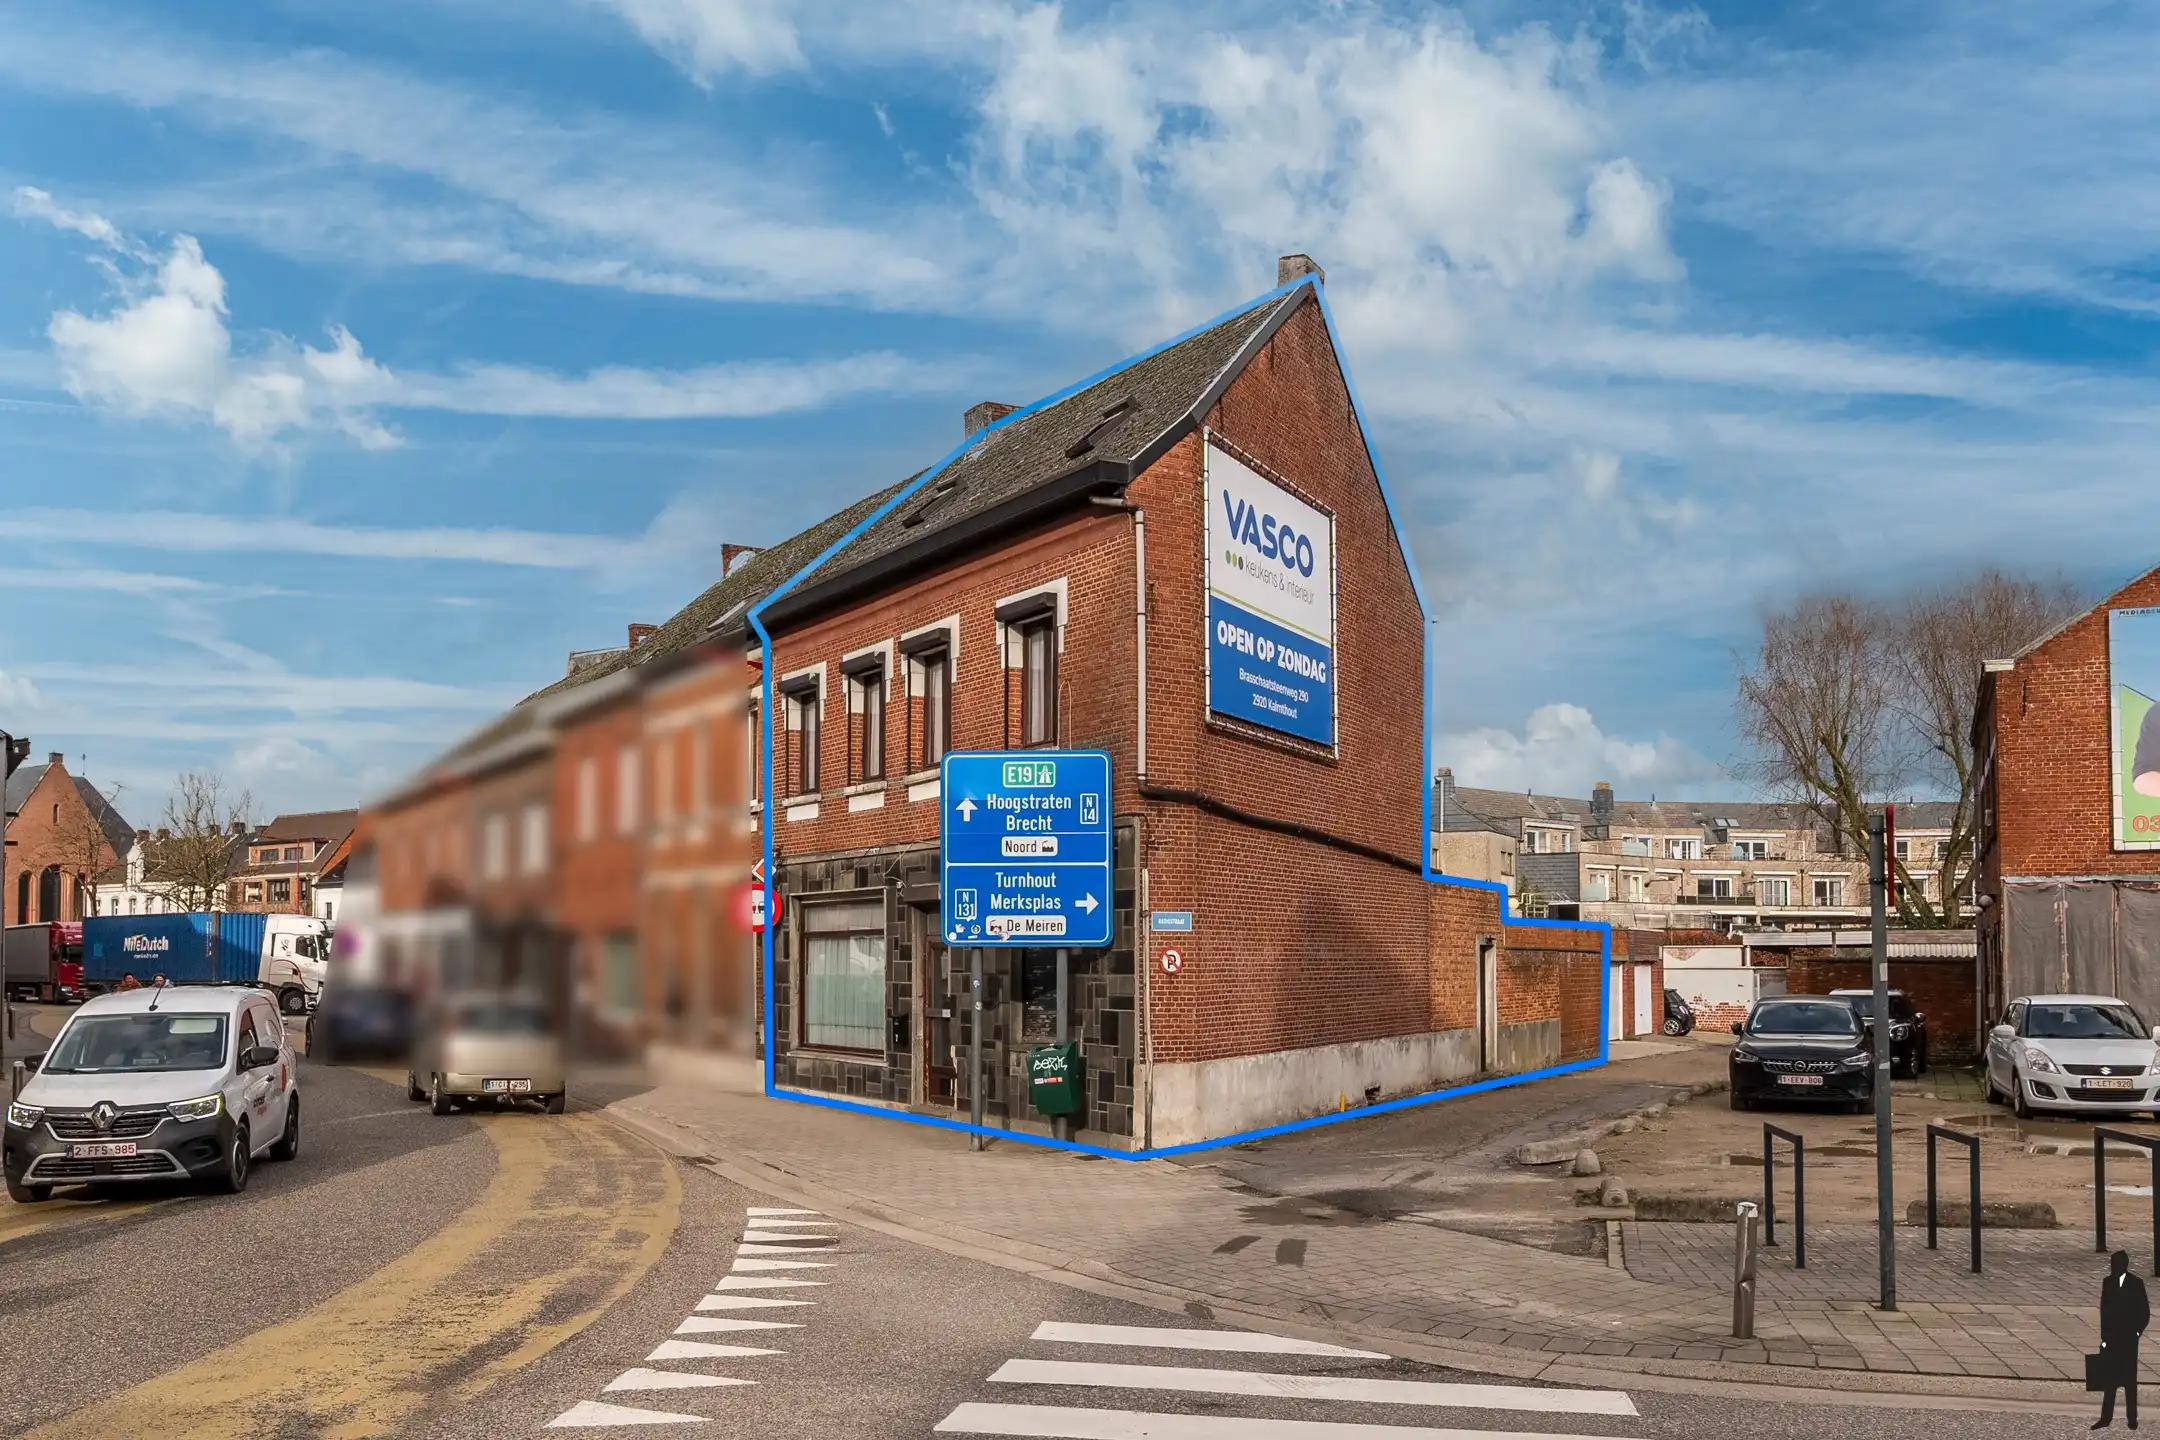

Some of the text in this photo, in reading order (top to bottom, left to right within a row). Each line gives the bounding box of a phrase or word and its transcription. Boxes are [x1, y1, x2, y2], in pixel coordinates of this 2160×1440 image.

[1223, 489, 1314, 578] VASCO
[1245, 555, 1315, 605] keukens & interieur
[1217, 620, 1326, 684] OPEN OP ZONDAG
[1239, 667, 1309, 703] Brasschaatsteenweg 290
[1267, 697, 1298, 719] Kalmthout
[1008, 766, 1032, 783] E19
[987, 793, 1072, 813] Hoogstraten
[1086, 797, 1092, 808] N
[1006, 815, 1052, 831] Brecht
[1083, 809, 1095, 821] 14
[1005, 840, 1037, 853] Noord
[995, 872, 1057, 888] Turnhout
[962, 892, 969, 902] N
[990, 893, 1061, 913] Merksplas
[958, 903, 975, 917] 131
[1007, 919, 1063, 932] De Meiren
[74, 1144, 135, 1156] 2-FFS-985
